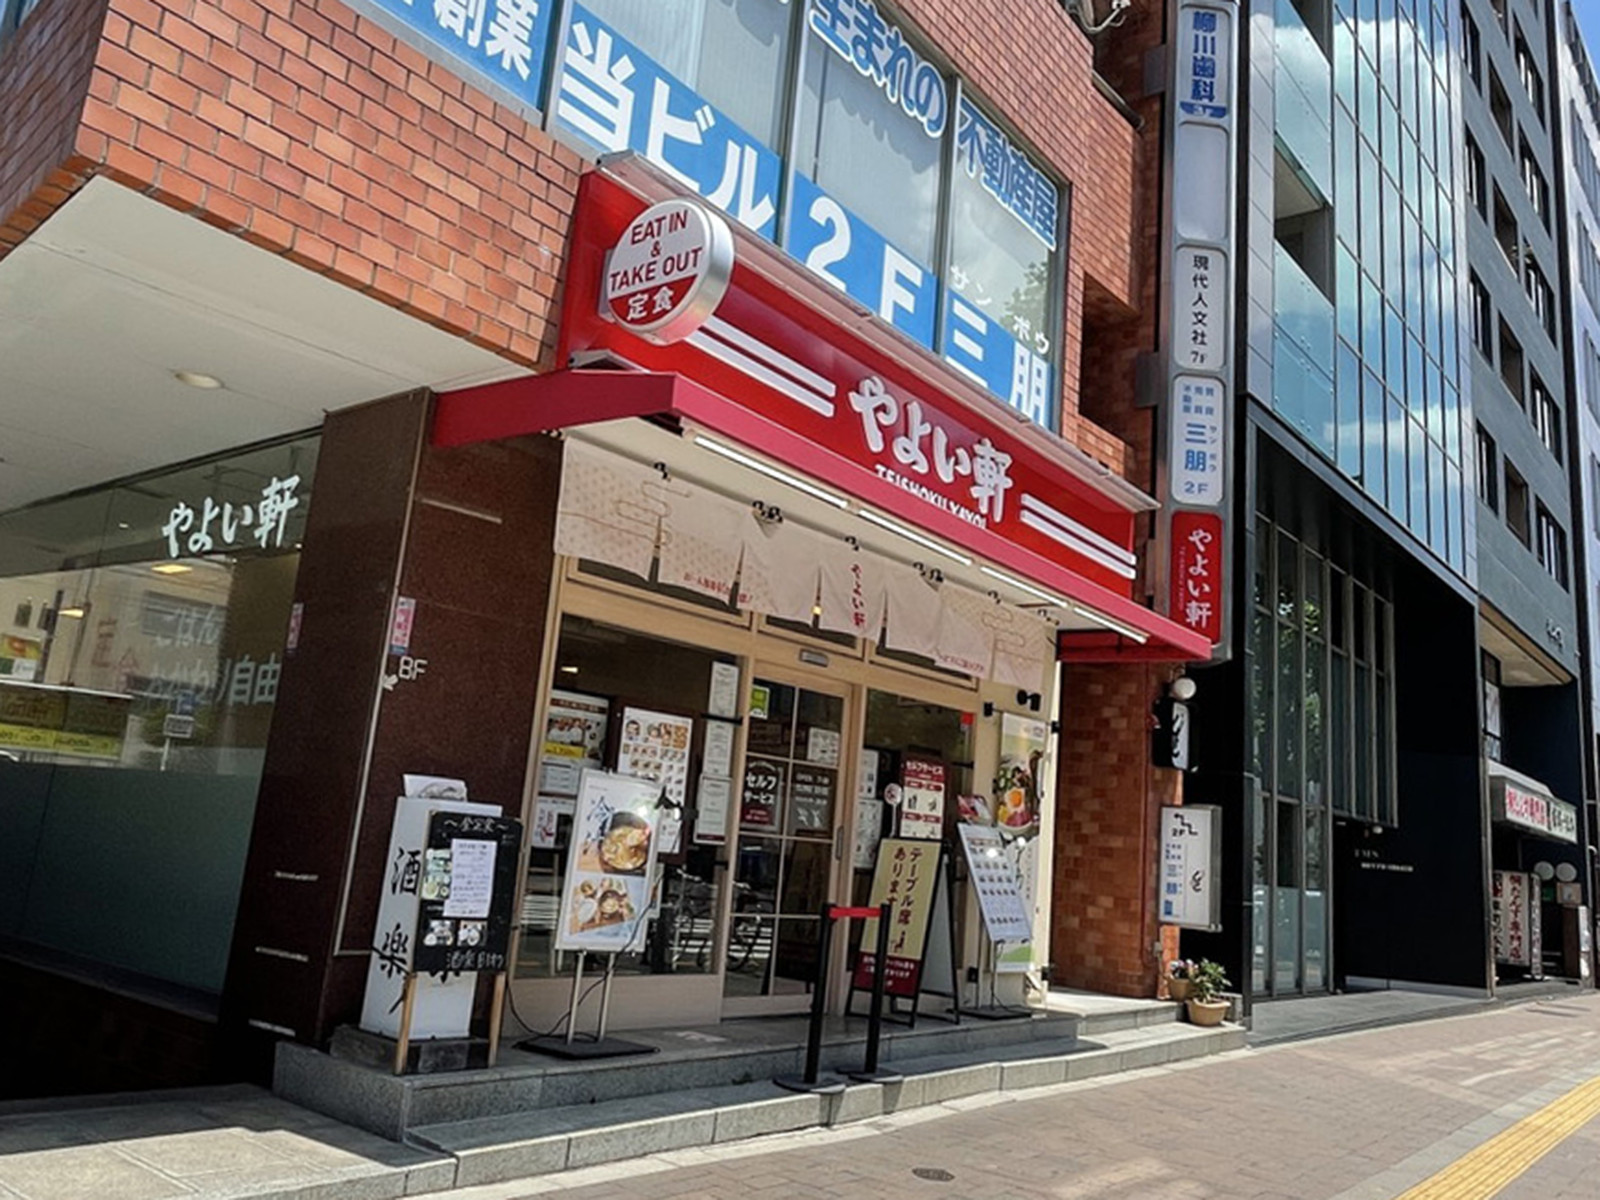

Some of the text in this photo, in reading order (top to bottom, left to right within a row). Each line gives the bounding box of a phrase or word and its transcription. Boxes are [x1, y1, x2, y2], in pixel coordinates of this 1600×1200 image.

[808, 0, 1057, 252] 生まれの 不動産屋
[404, 0, 1048, 428] 創業 当ビル 2F 三朋
[630, 209, 688, 247] EAT IN
[609, 246, 704, 293] TAKE OUT
[650, 240, 662, 258] &
[627, 286, 676, 321] 定食
[1190, 255, 1209, 364] 現代人文社 7F
[848, 375, 1015, 523] やよい軒
[1185, 422, 1206, 472] 三朋
[1184, 481, 1208, 494] 2F
[162, 474, 301, 558] やよい軒
[1186, 528, 1213, 628] やよい軒
[400, 656, 428, 681] BF
[741, 772, 777, 790] セルフ
[901, 847, 923, 925] テーブル席
